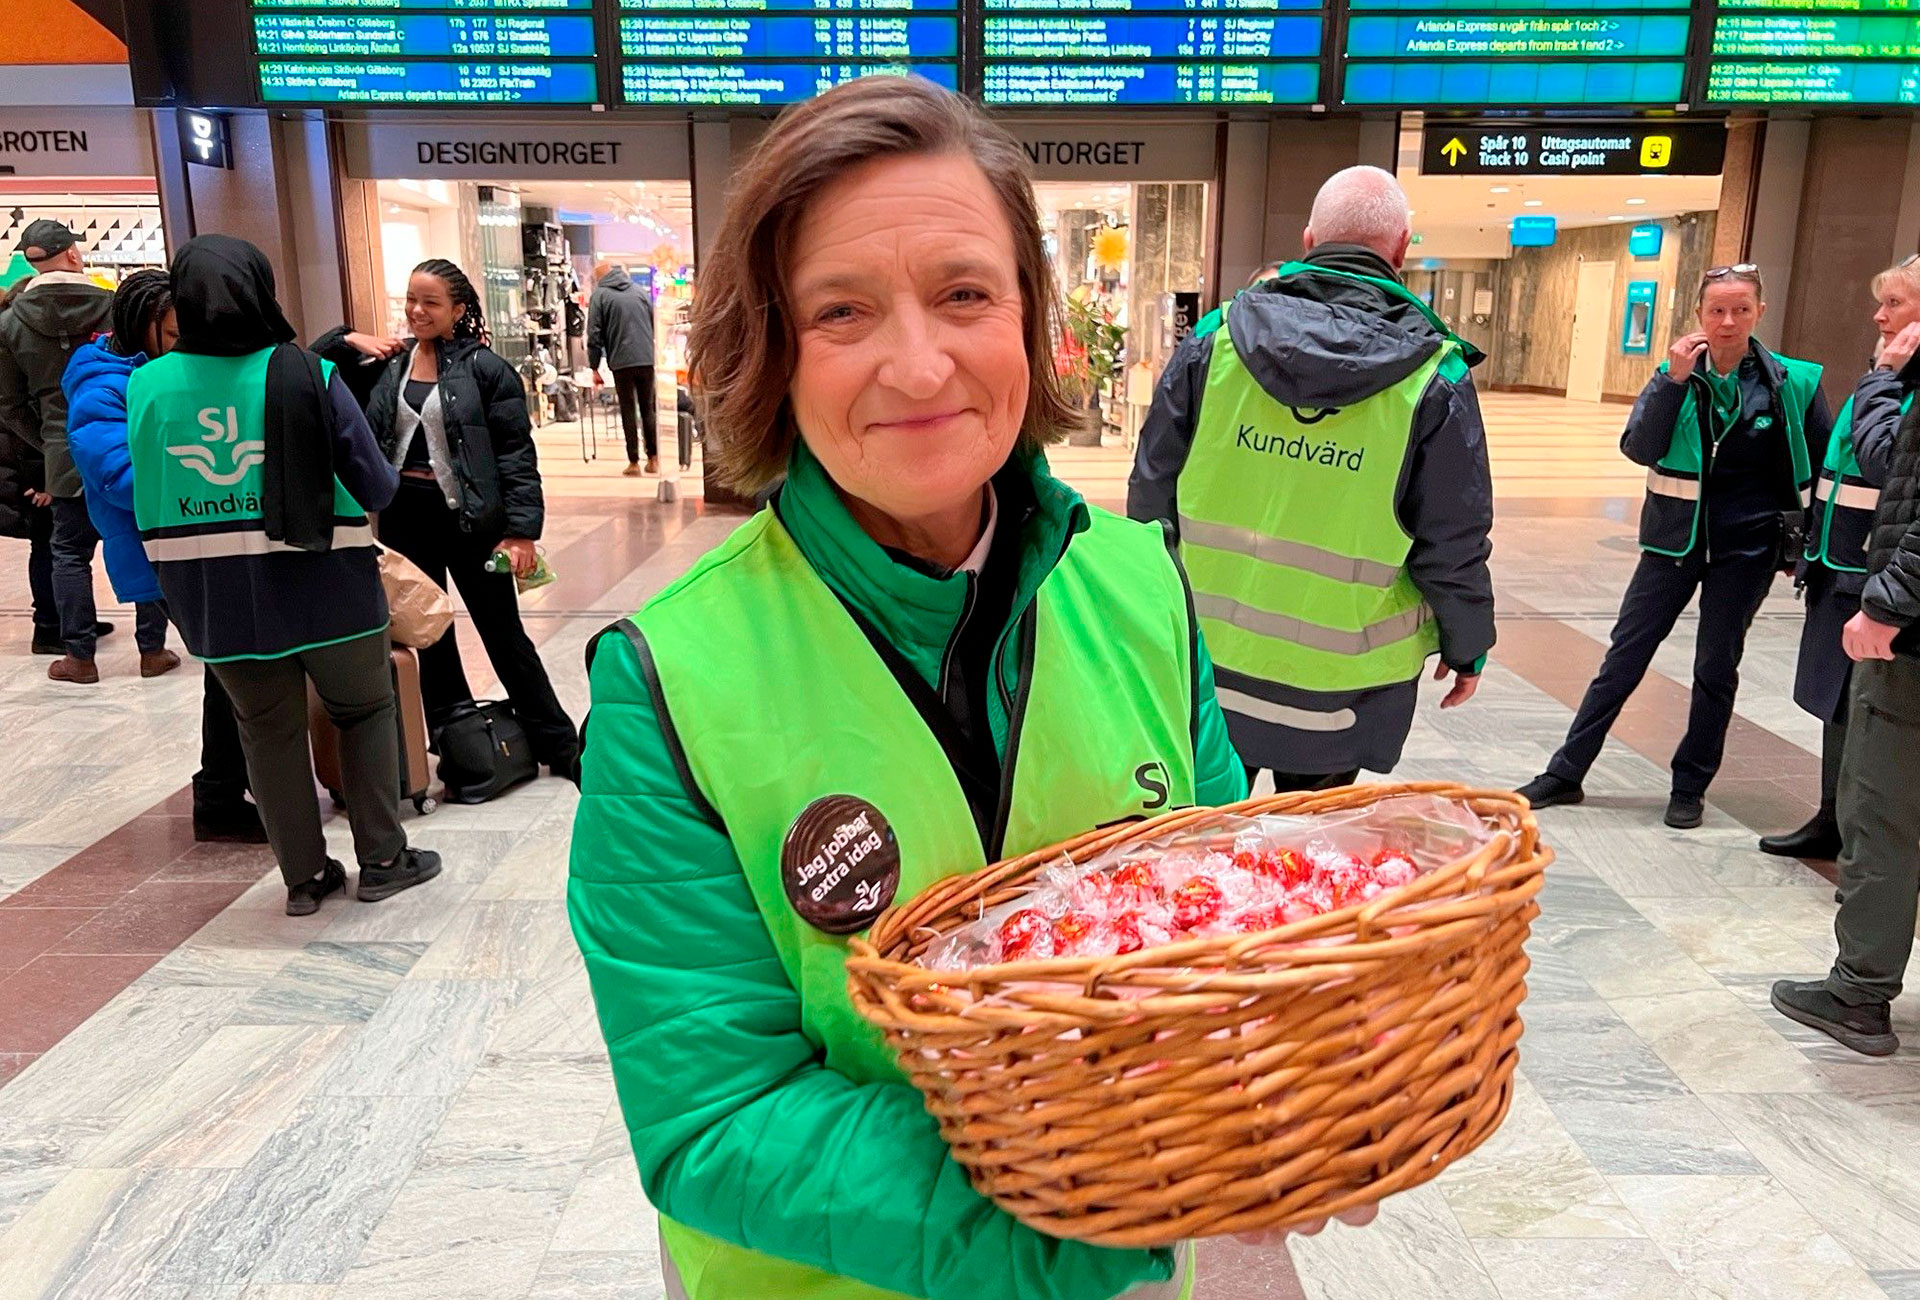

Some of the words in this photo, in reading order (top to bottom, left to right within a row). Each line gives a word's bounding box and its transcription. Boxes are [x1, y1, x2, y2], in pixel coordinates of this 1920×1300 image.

[317, 16, 345, 27] Örebro
[357, 19, 395, 29] Göteborg
[495, 19, 506, 28] SJ
[508, 19, 544, 30] Regional
[1417, 21, 1457, 31] Arlanda
[1456, 21, 1498, 33] Express
[1499, 20, 1528, 33] avgår
[1530, 19, 1550, 31] från
[1551, 20, 1573, 33] spår
[256, 30, 278, 39] 14:21
[356, 31, 395, 40] Sundsvall
[496, 31, 508, 40] SJ
[258, 43, 280, 52] 14:21
[283, 44, 328, 54] Norrköping
[329, 44, 369, 54] Linköping
[498, 44, 509, 53] SJ
[1223, 44, 1234, 55] SJ
[1407, 40, 1446, 50] Arlanda
[1447, 40, 1488, 52] Express
[1489, 40, 1527, 52] departs
[1528, 40, 1553, 50] from
[1554, 40, 1579, 50] track
[284, 65, 332, 73] Katrineholm
[334, 66, 365, 74] Skövde
[367, 66, 405, 76] Göteborg
[499, 66, 510, 75] SJ
[285, 77, 316, 86] Skövde
[318, 78, 356, 88] Göteborg
[339, 91, 369, 99] Arlanda
[371, 90, 404, 101] Express
[406, 91, 436, 101] departs
[437, 91, 456, 100] from
[457, 91, 478, 100] track
[487, 91, 503, 101] and
[0, 131, 88, 152] ROTEN
[1480, 135, 1509, 151] Spår
[1511, 136, 1526, 150] 10
[1541, 135, 1632, 152] Uttagsautomat
[417, 142, 622, 164] DESIGNTORGET
[1479, 151, 1511, 166] Track
[1512, 152, 1528, 166] 10
[1539, 151, 1570, 166] Cash
[1571, 152, 1605, 168] point
[197, 406, 239, 443] SJ
[1236, 424, 1365, 472] Kundvärd
[797, 854, 828, 886] Jag
[821, 810, 869, 865] jobbar
[811, 862, 850, 902] extra
[845, 830, 883, 867] idag
[854, 880, 871, 899] SJ
